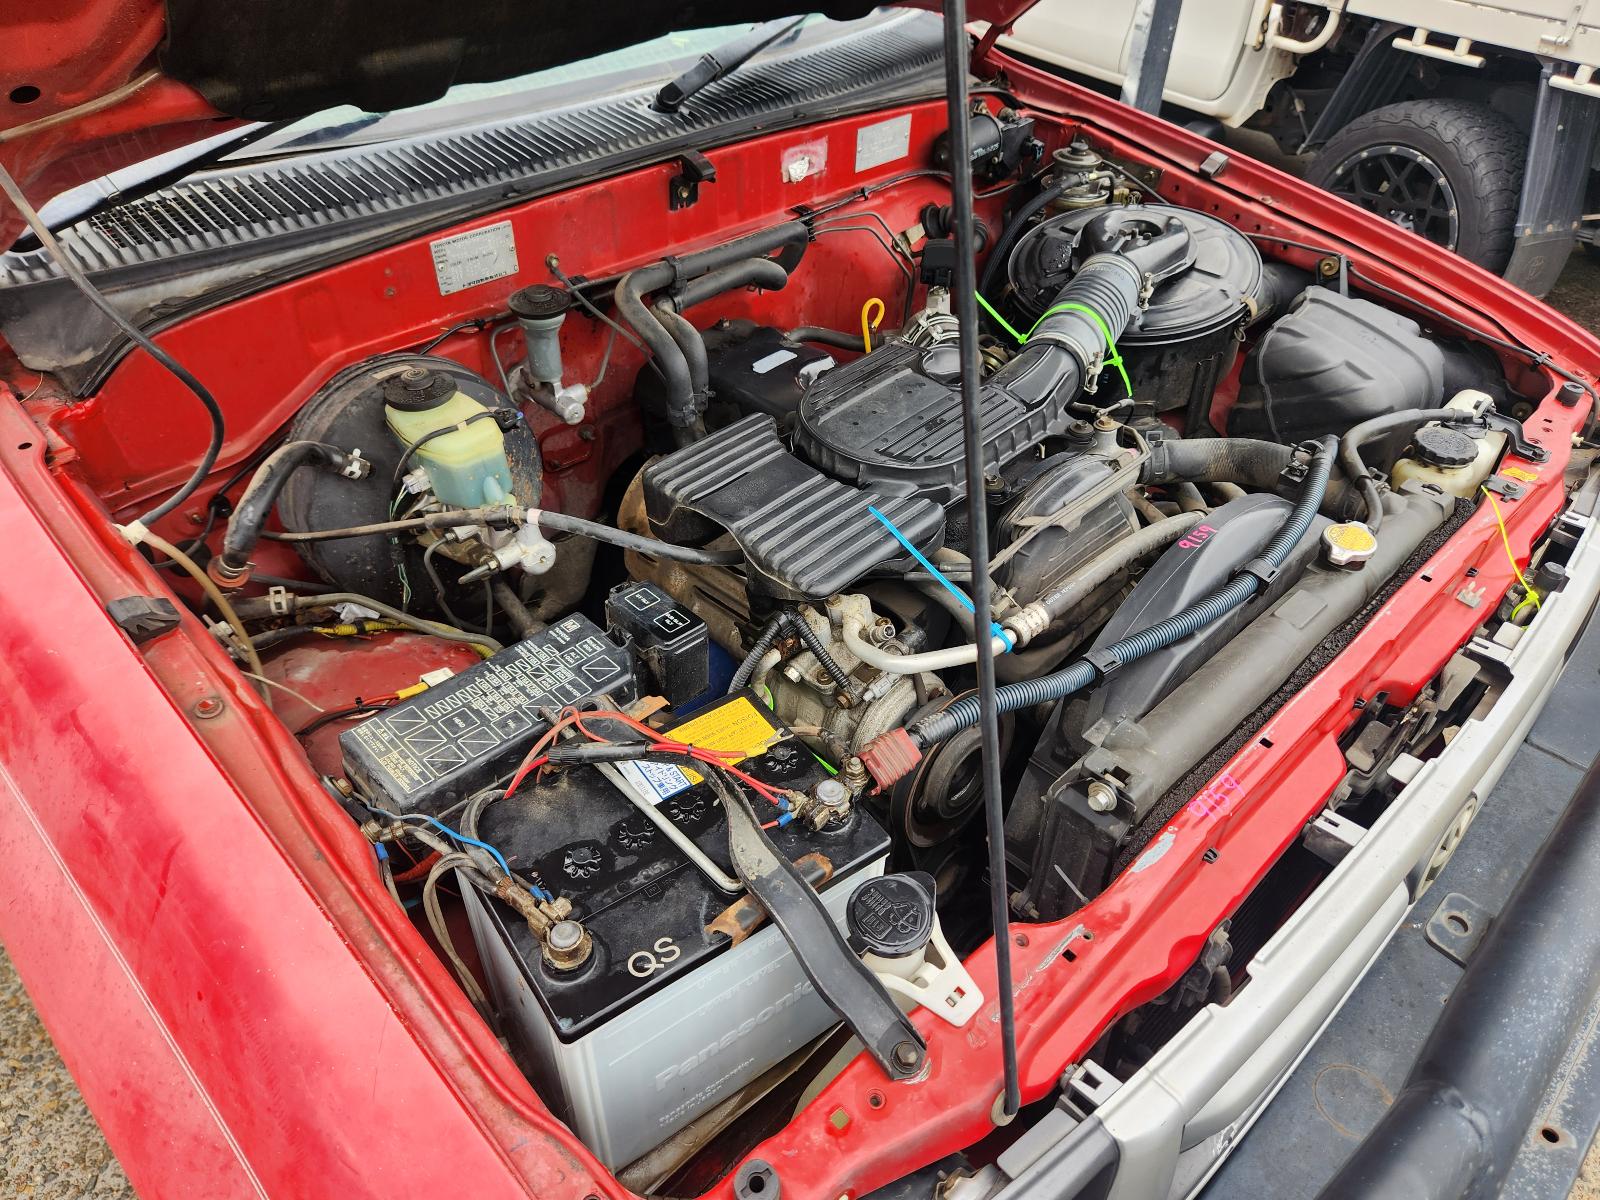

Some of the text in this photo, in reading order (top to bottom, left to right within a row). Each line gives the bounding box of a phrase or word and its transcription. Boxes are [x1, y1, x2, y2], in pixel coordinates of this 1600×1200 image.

[433, 240, 451, 249] TOYOTA
[452, 235, 468, 244] MOTOR
[469, 226, 501, 239] CORPORATION
[1178, 524, 1217, 549] 9159
[563, 682, 582, 698] HEATER
[731, 710, 758, 728] POISON
[405, 757, 423, 774] NOTICE
[670, 770, 688, 787] START
[1189, 772, 1245, 821] 9159
[627, 936, 682, 978] QS
[655, 980, 816, 1092] Panasonic
